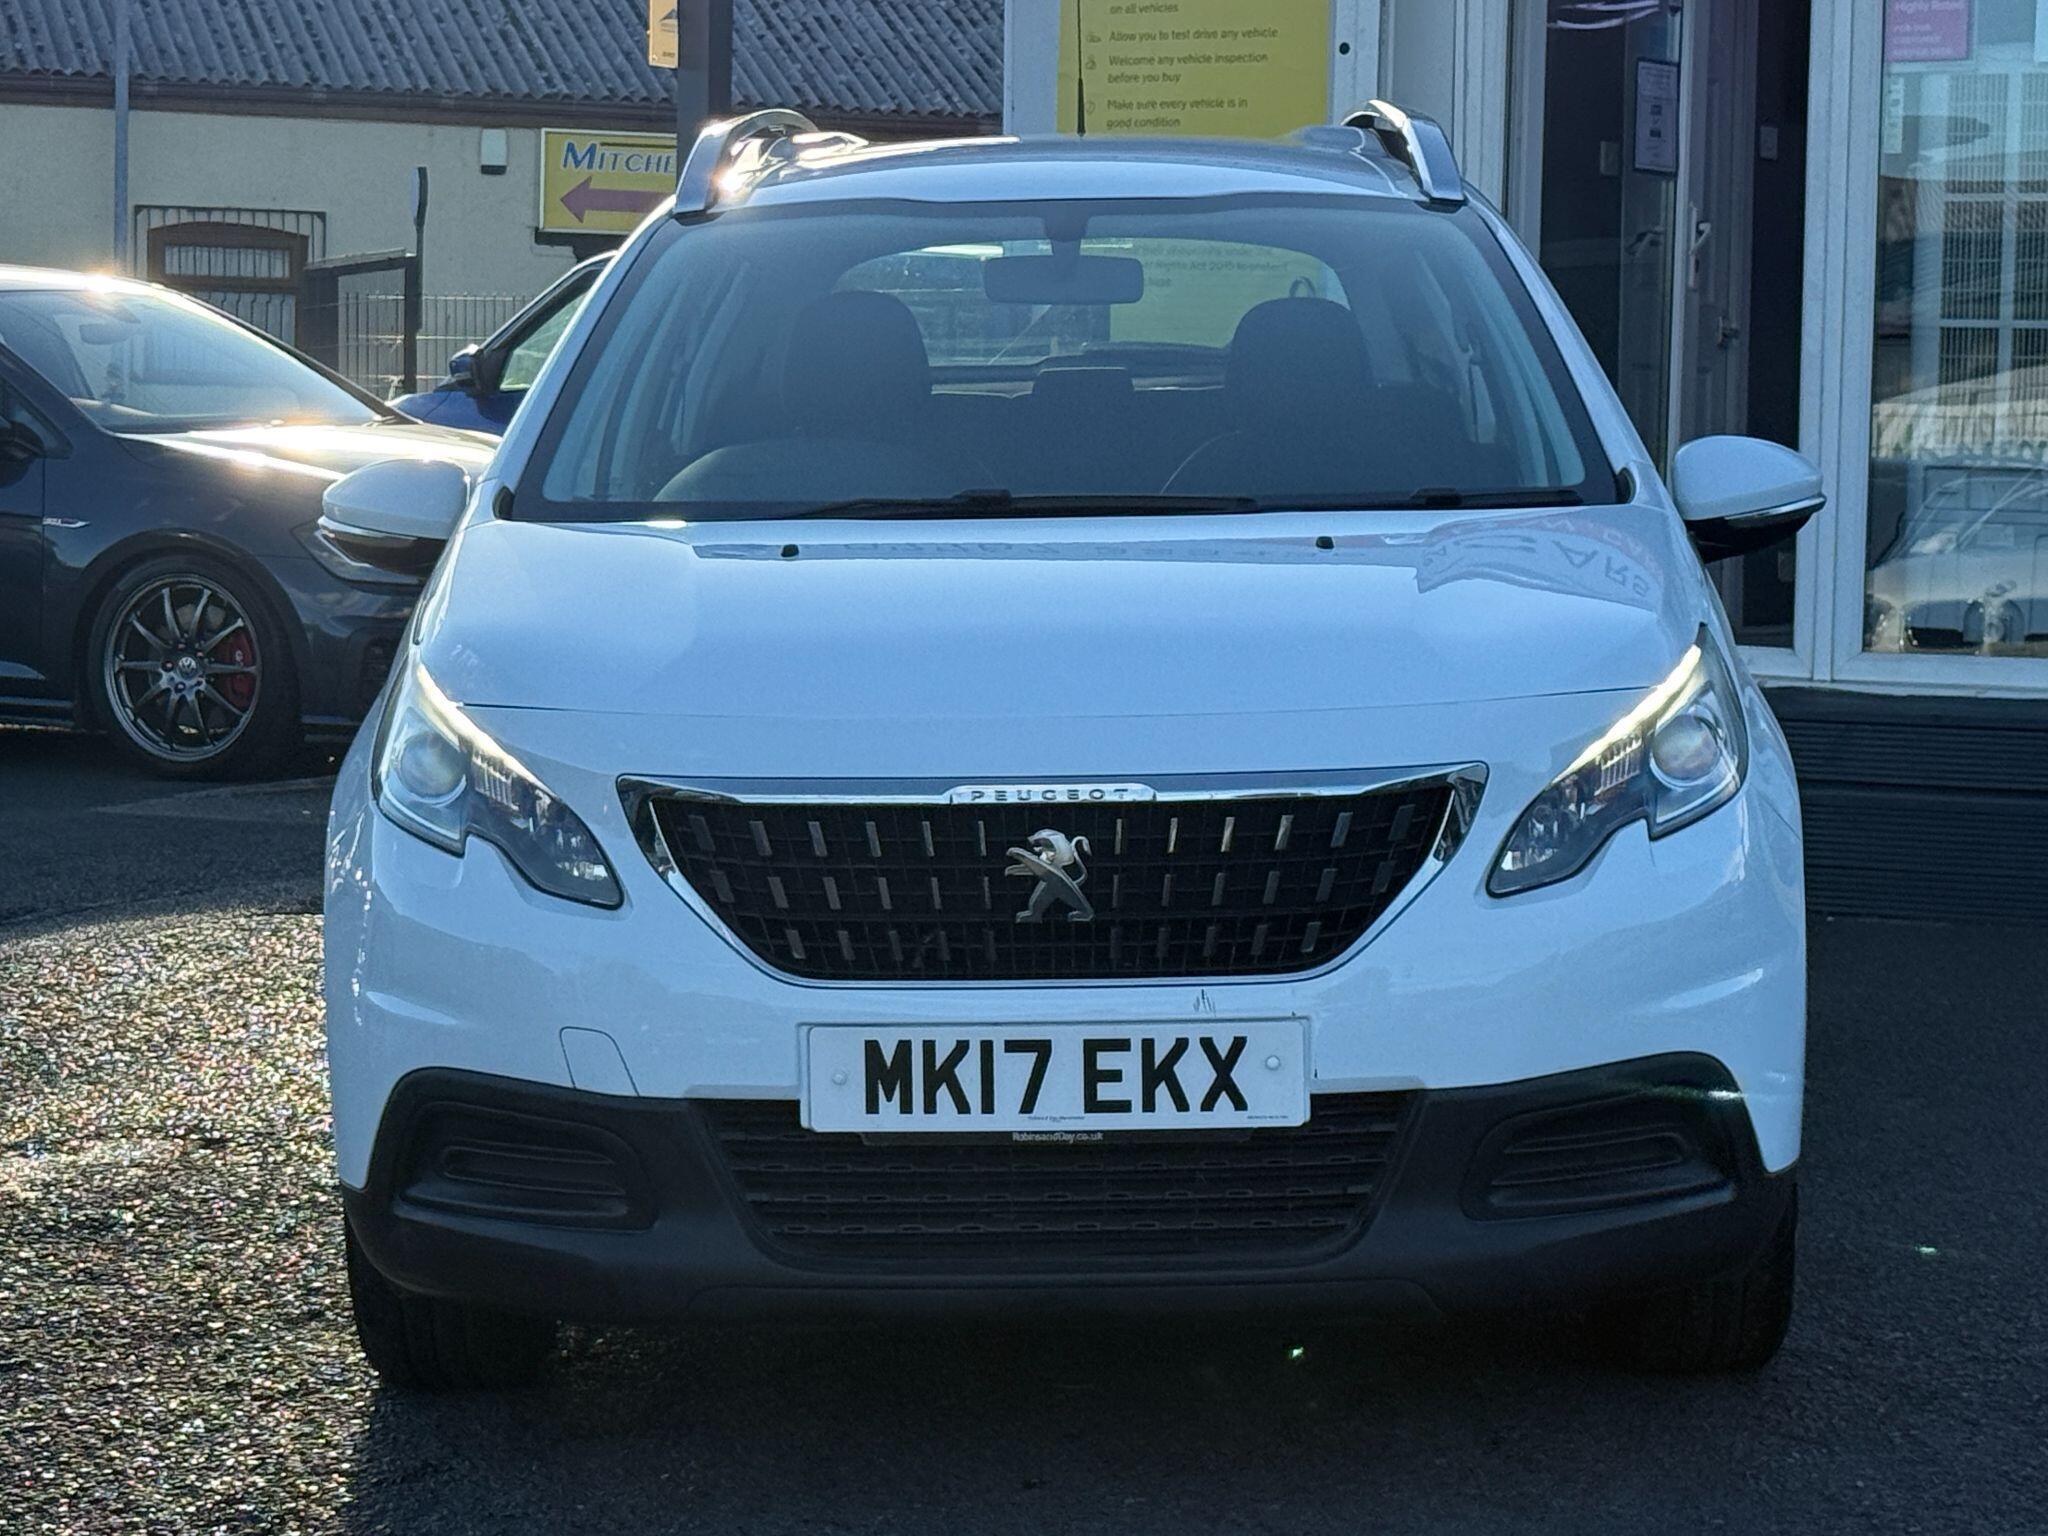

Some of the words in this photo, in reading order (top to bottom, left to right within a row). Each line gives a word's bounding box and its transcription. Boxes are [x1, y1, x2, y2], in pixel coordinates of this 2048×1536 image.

[1110, 5, 1123, 14] on
[1125, 3, 1137, 13] all
[1139, 3, 1179, 13] vehicles
[1109, 31, 1137, 42] Allow
[1138, 33, 1157, 43] you
[1159, 31, 1170, 40] to
[1171, 30, 1190, 40] test
[1193, 29, 1218, 39] drive
[1221, 30, 1238, 41] any
[1241, 28, 1279, 38] vehicle
[1109, 55, 1155, 66] Welcome
[1157, 56, 1175, 66] any
[1177, 54, 1213, 64] vehicle
[1215, 53, 1269, 65] inspection
[1107, 72, 1139, 83] before
[1142, 74, 1159, 84] you
[1162, 72, 1181, 85] buy
[1107, 99, 1134, 110] Make
[1136, 101, 1157, 110] sure
[1159, 101, 1187, 111] every
[1189, 98, 1224, 109] vehicle
[1227, 98, 1236, 108] is
[1238, 98, 1248, 108] in
[1106, 118, 1132, 129] good
[1134, 116, 1181, 128] condition
[970, 788, 1129, 802] PEUGEOT
[863, 1038, 1053, 1115] MK17
[1082, 1035, 1249, 1114] EKX
